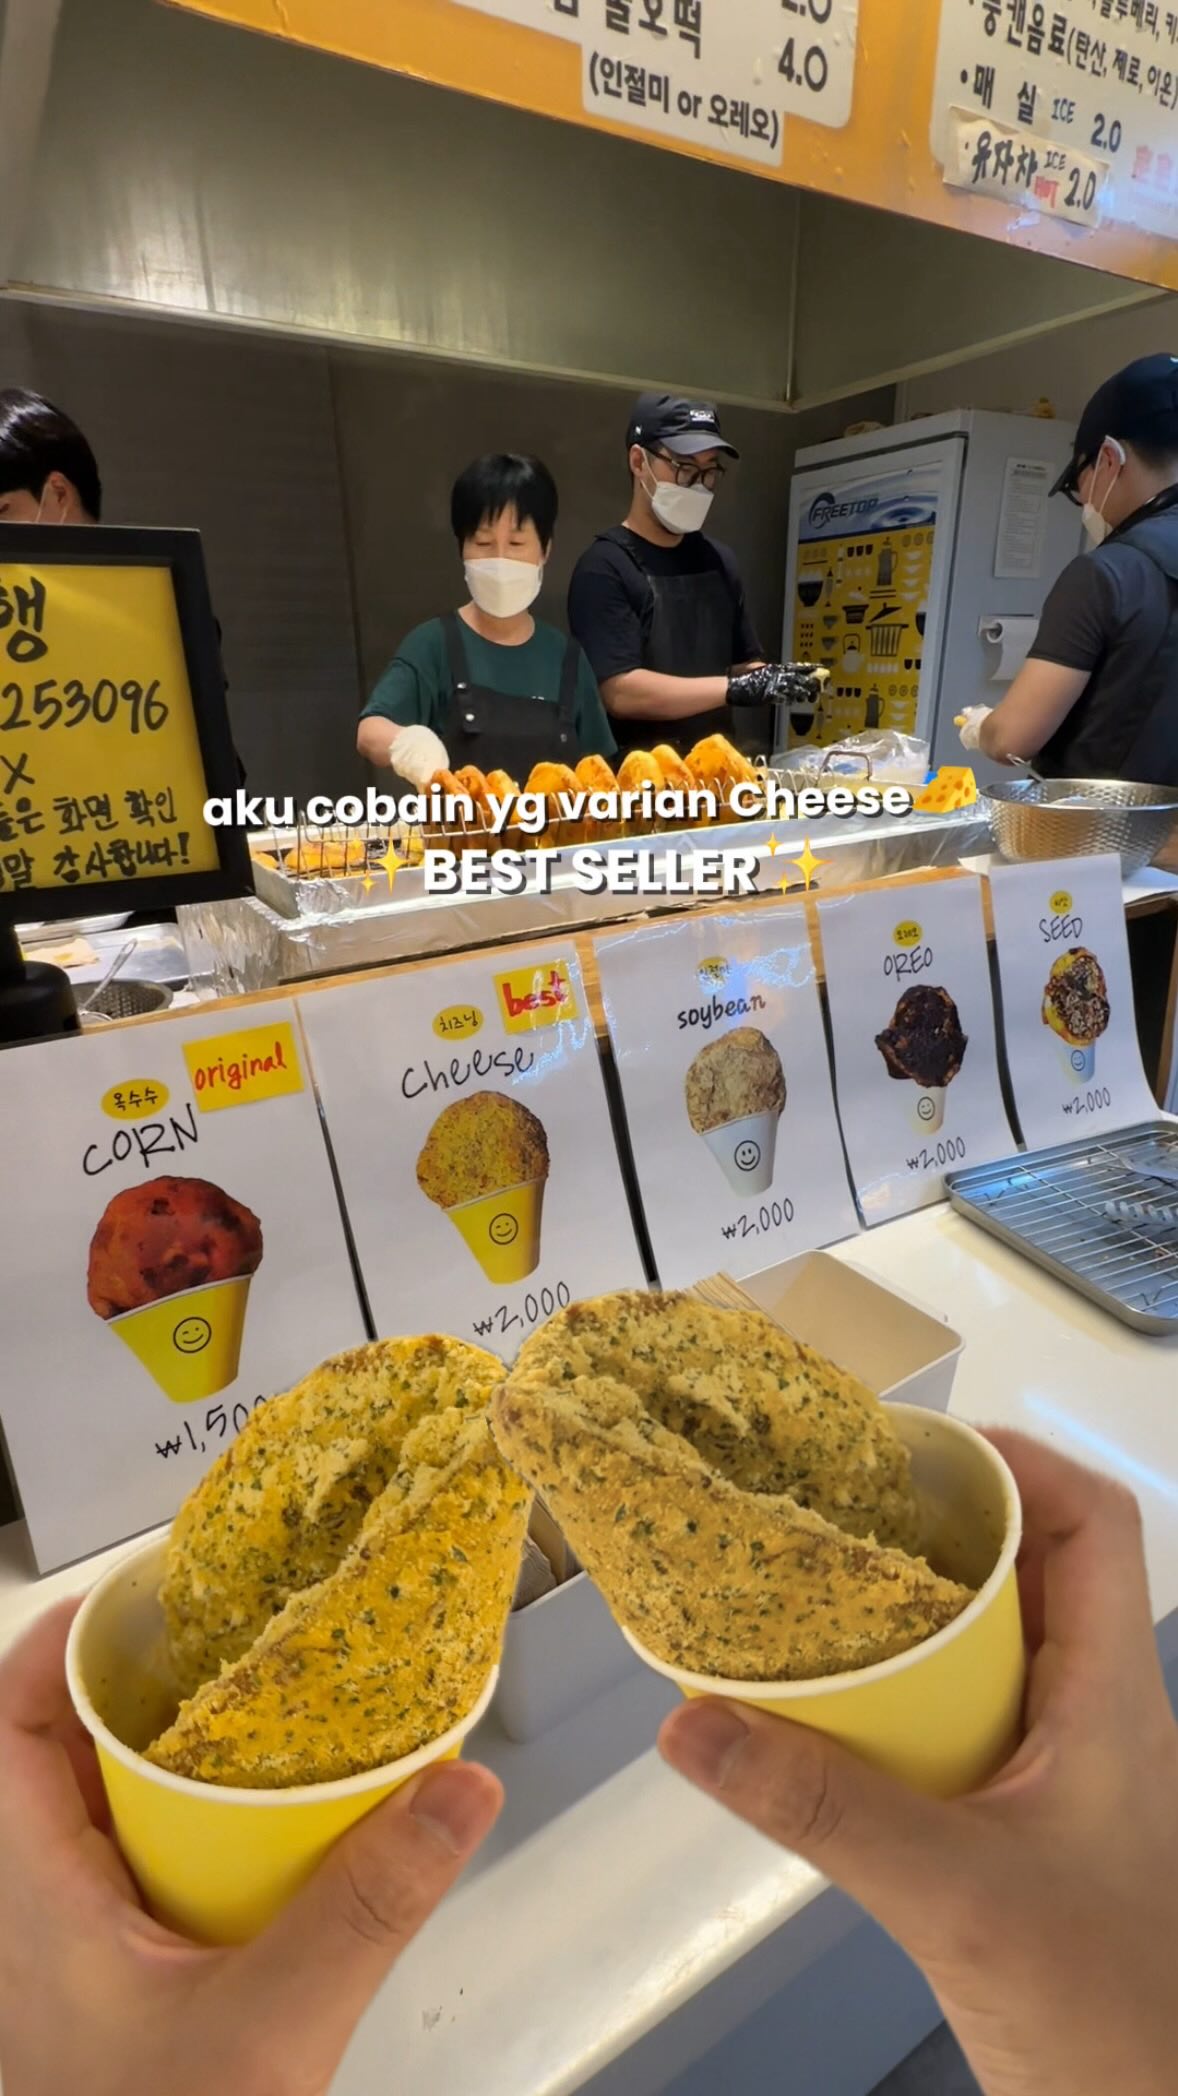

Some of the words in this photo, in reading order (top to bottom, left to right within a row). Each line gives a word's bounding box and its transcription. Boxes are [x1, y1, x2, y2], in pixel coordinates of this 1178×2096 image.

[778, 37, 828, 92] 4.0
[589, 51, 669, 113] (인절미
[677, 91, 702, 118] or
[707, 94, 779, 149] 오레오)
[1051, 98, 1075, 124] ICE
[1090, 113, 1121, 153] 2.0
[971, 131, 1038, 188] 유자차
[1064, 167, 1097, 211] 2.0
[812, 497, 879, 523] FREETOP
[1, 680, 169, 735] 253096
[53, 793, 119, 834] 화면
[124, 787, 177, 827] 확인
[0, 848, 36, 892] 말
[1039, 914, 1083, 943] SEED
[884, 946, 933, 982] OREO
[502, 970, 567, 1018] best
[677, 994, 766, 1030] soybean
[195, 1041, 287, 1090] original
[402, 1047, 533, 1098] Cheese
[113, 1086, 159, 1111] 옥수수
[1062, 1087, 1111, 1115] ₩2,000
[83, 1103, 198, 1176] CORN
[907, 1136, 966, 1170] ₩2,000
[721, 1198, 794, 1240] ₩2,000
[473, 1281, 570, 1337] ₩2,000
[155, 1395, 267, 1458] ₩1,50
